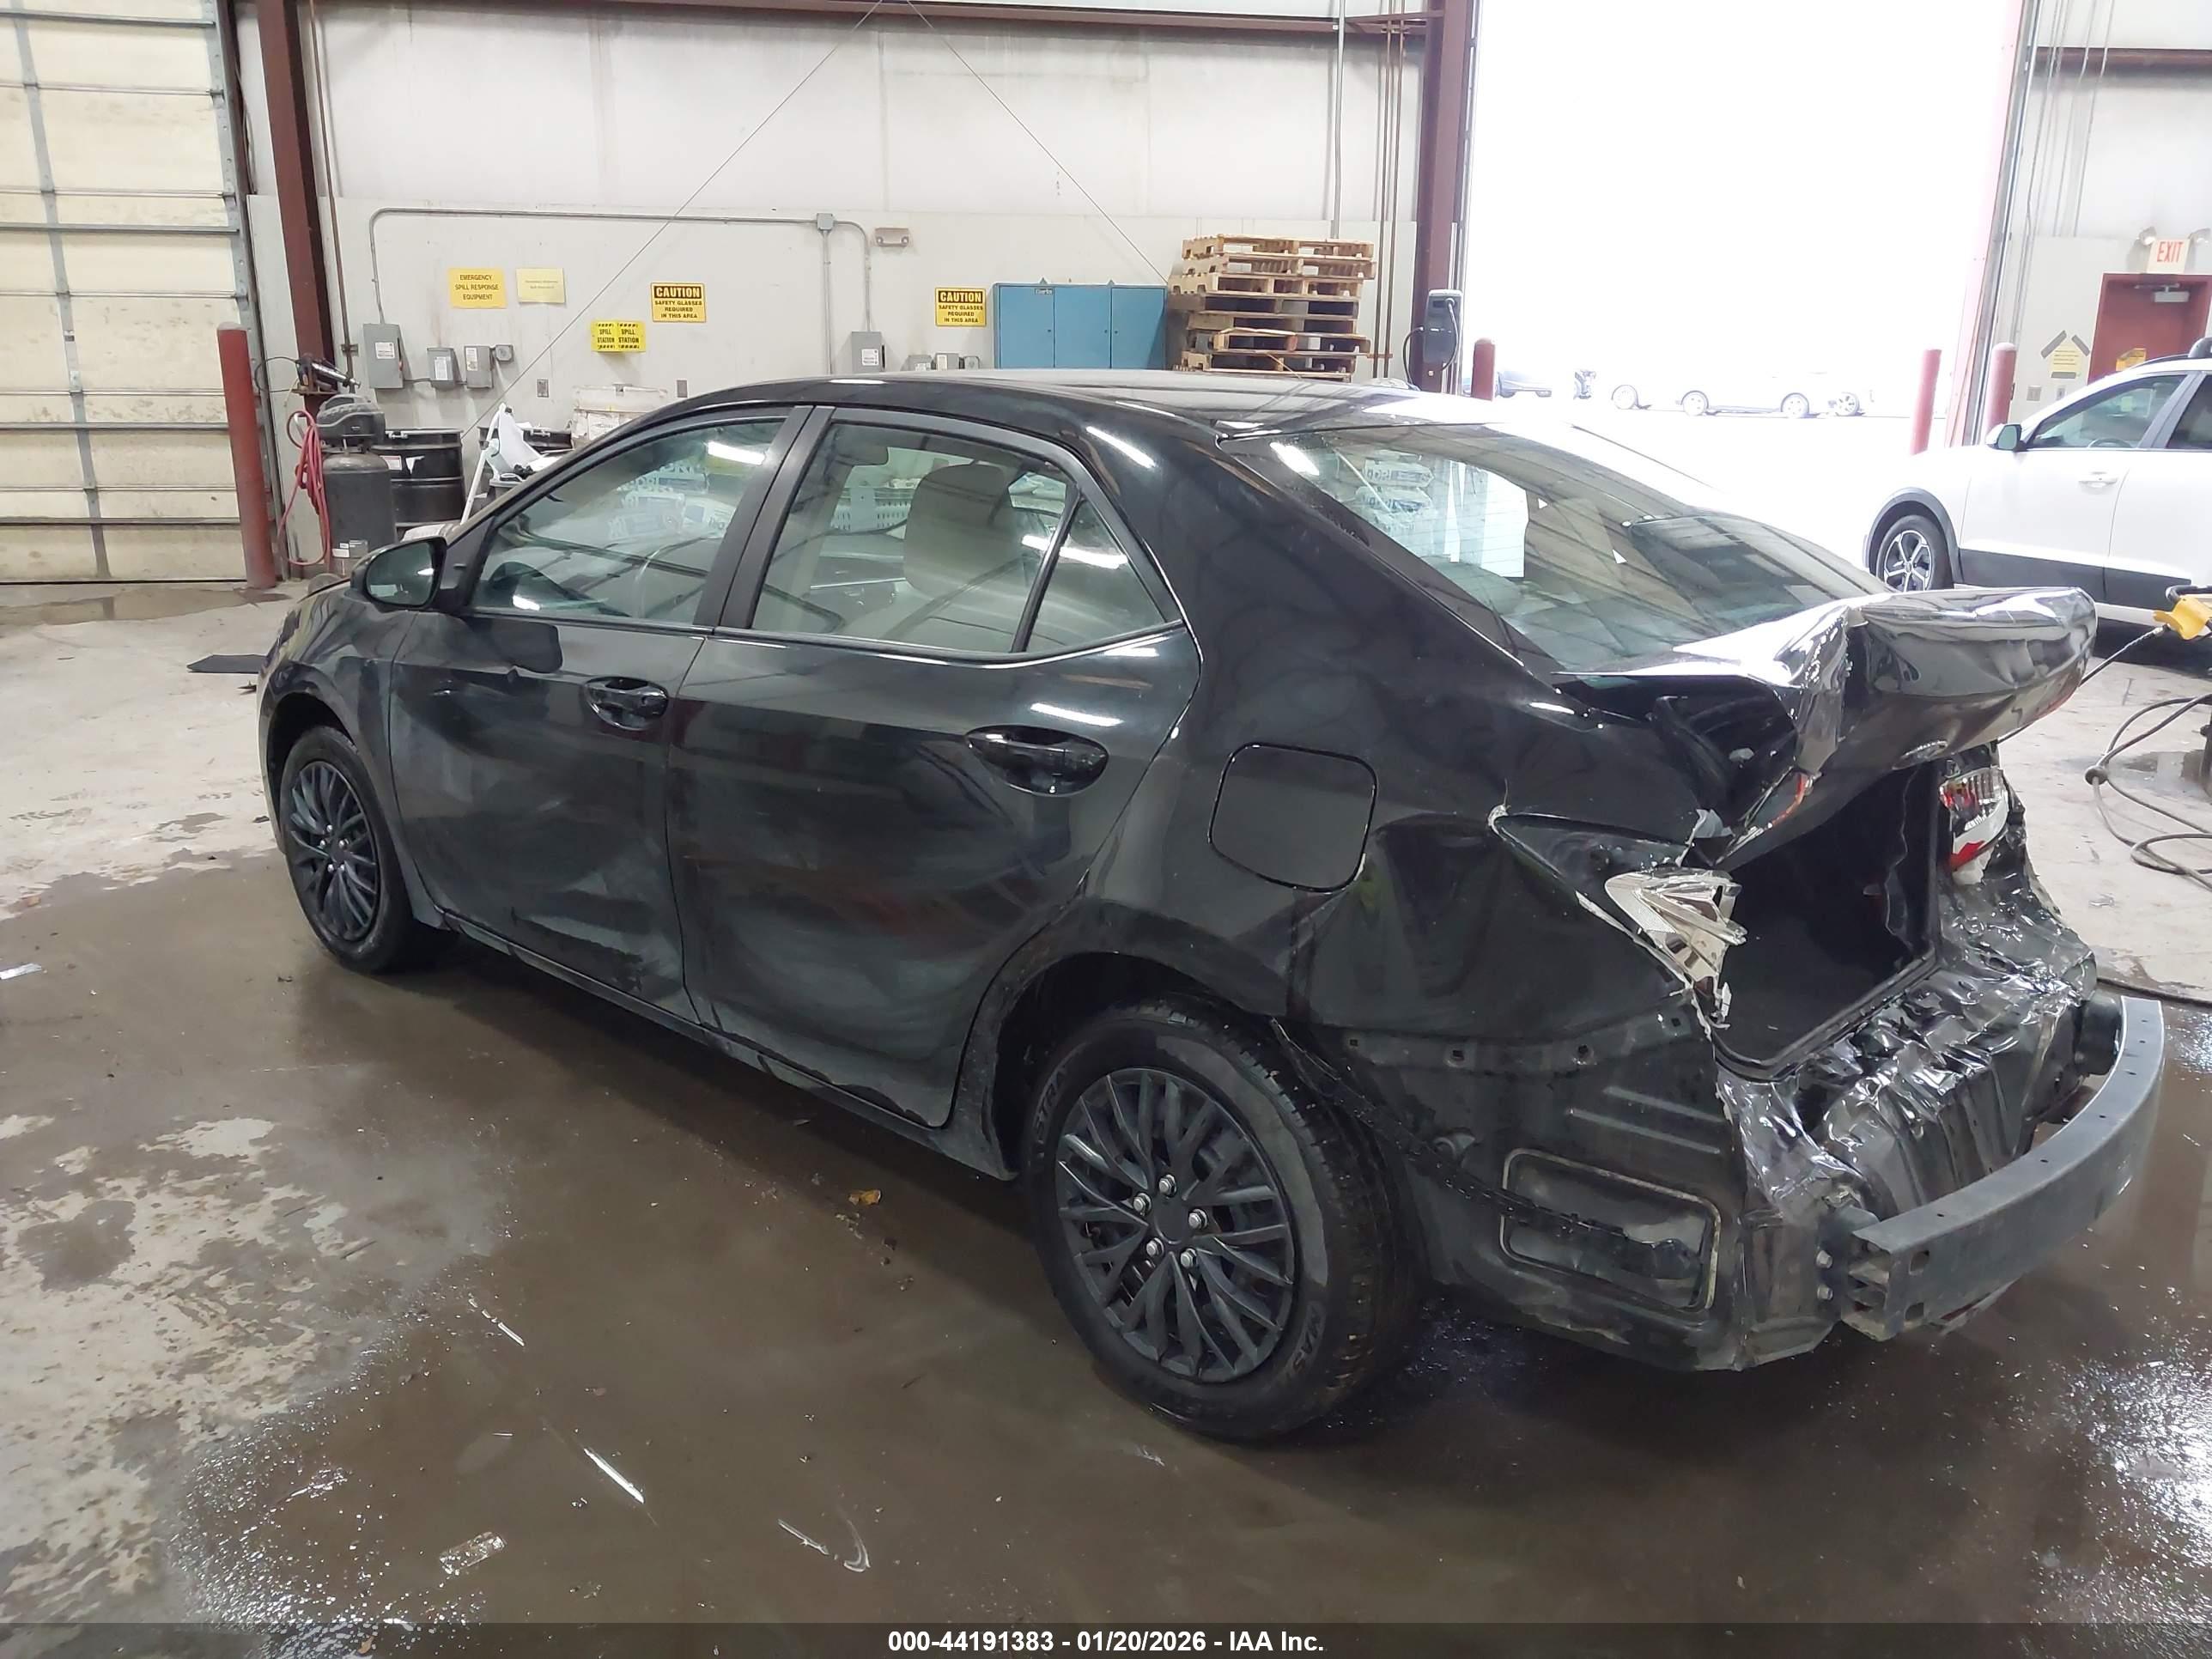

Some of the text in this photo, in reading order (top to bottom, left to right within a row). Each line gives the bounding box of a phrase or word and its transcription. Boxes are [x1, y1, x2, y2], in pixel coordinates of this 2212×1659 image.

[2156, 240, 2184, 262] EXIT
[655, 287, 700, 298] CAUTION
[939, 291, 981, 302] CAUTION
